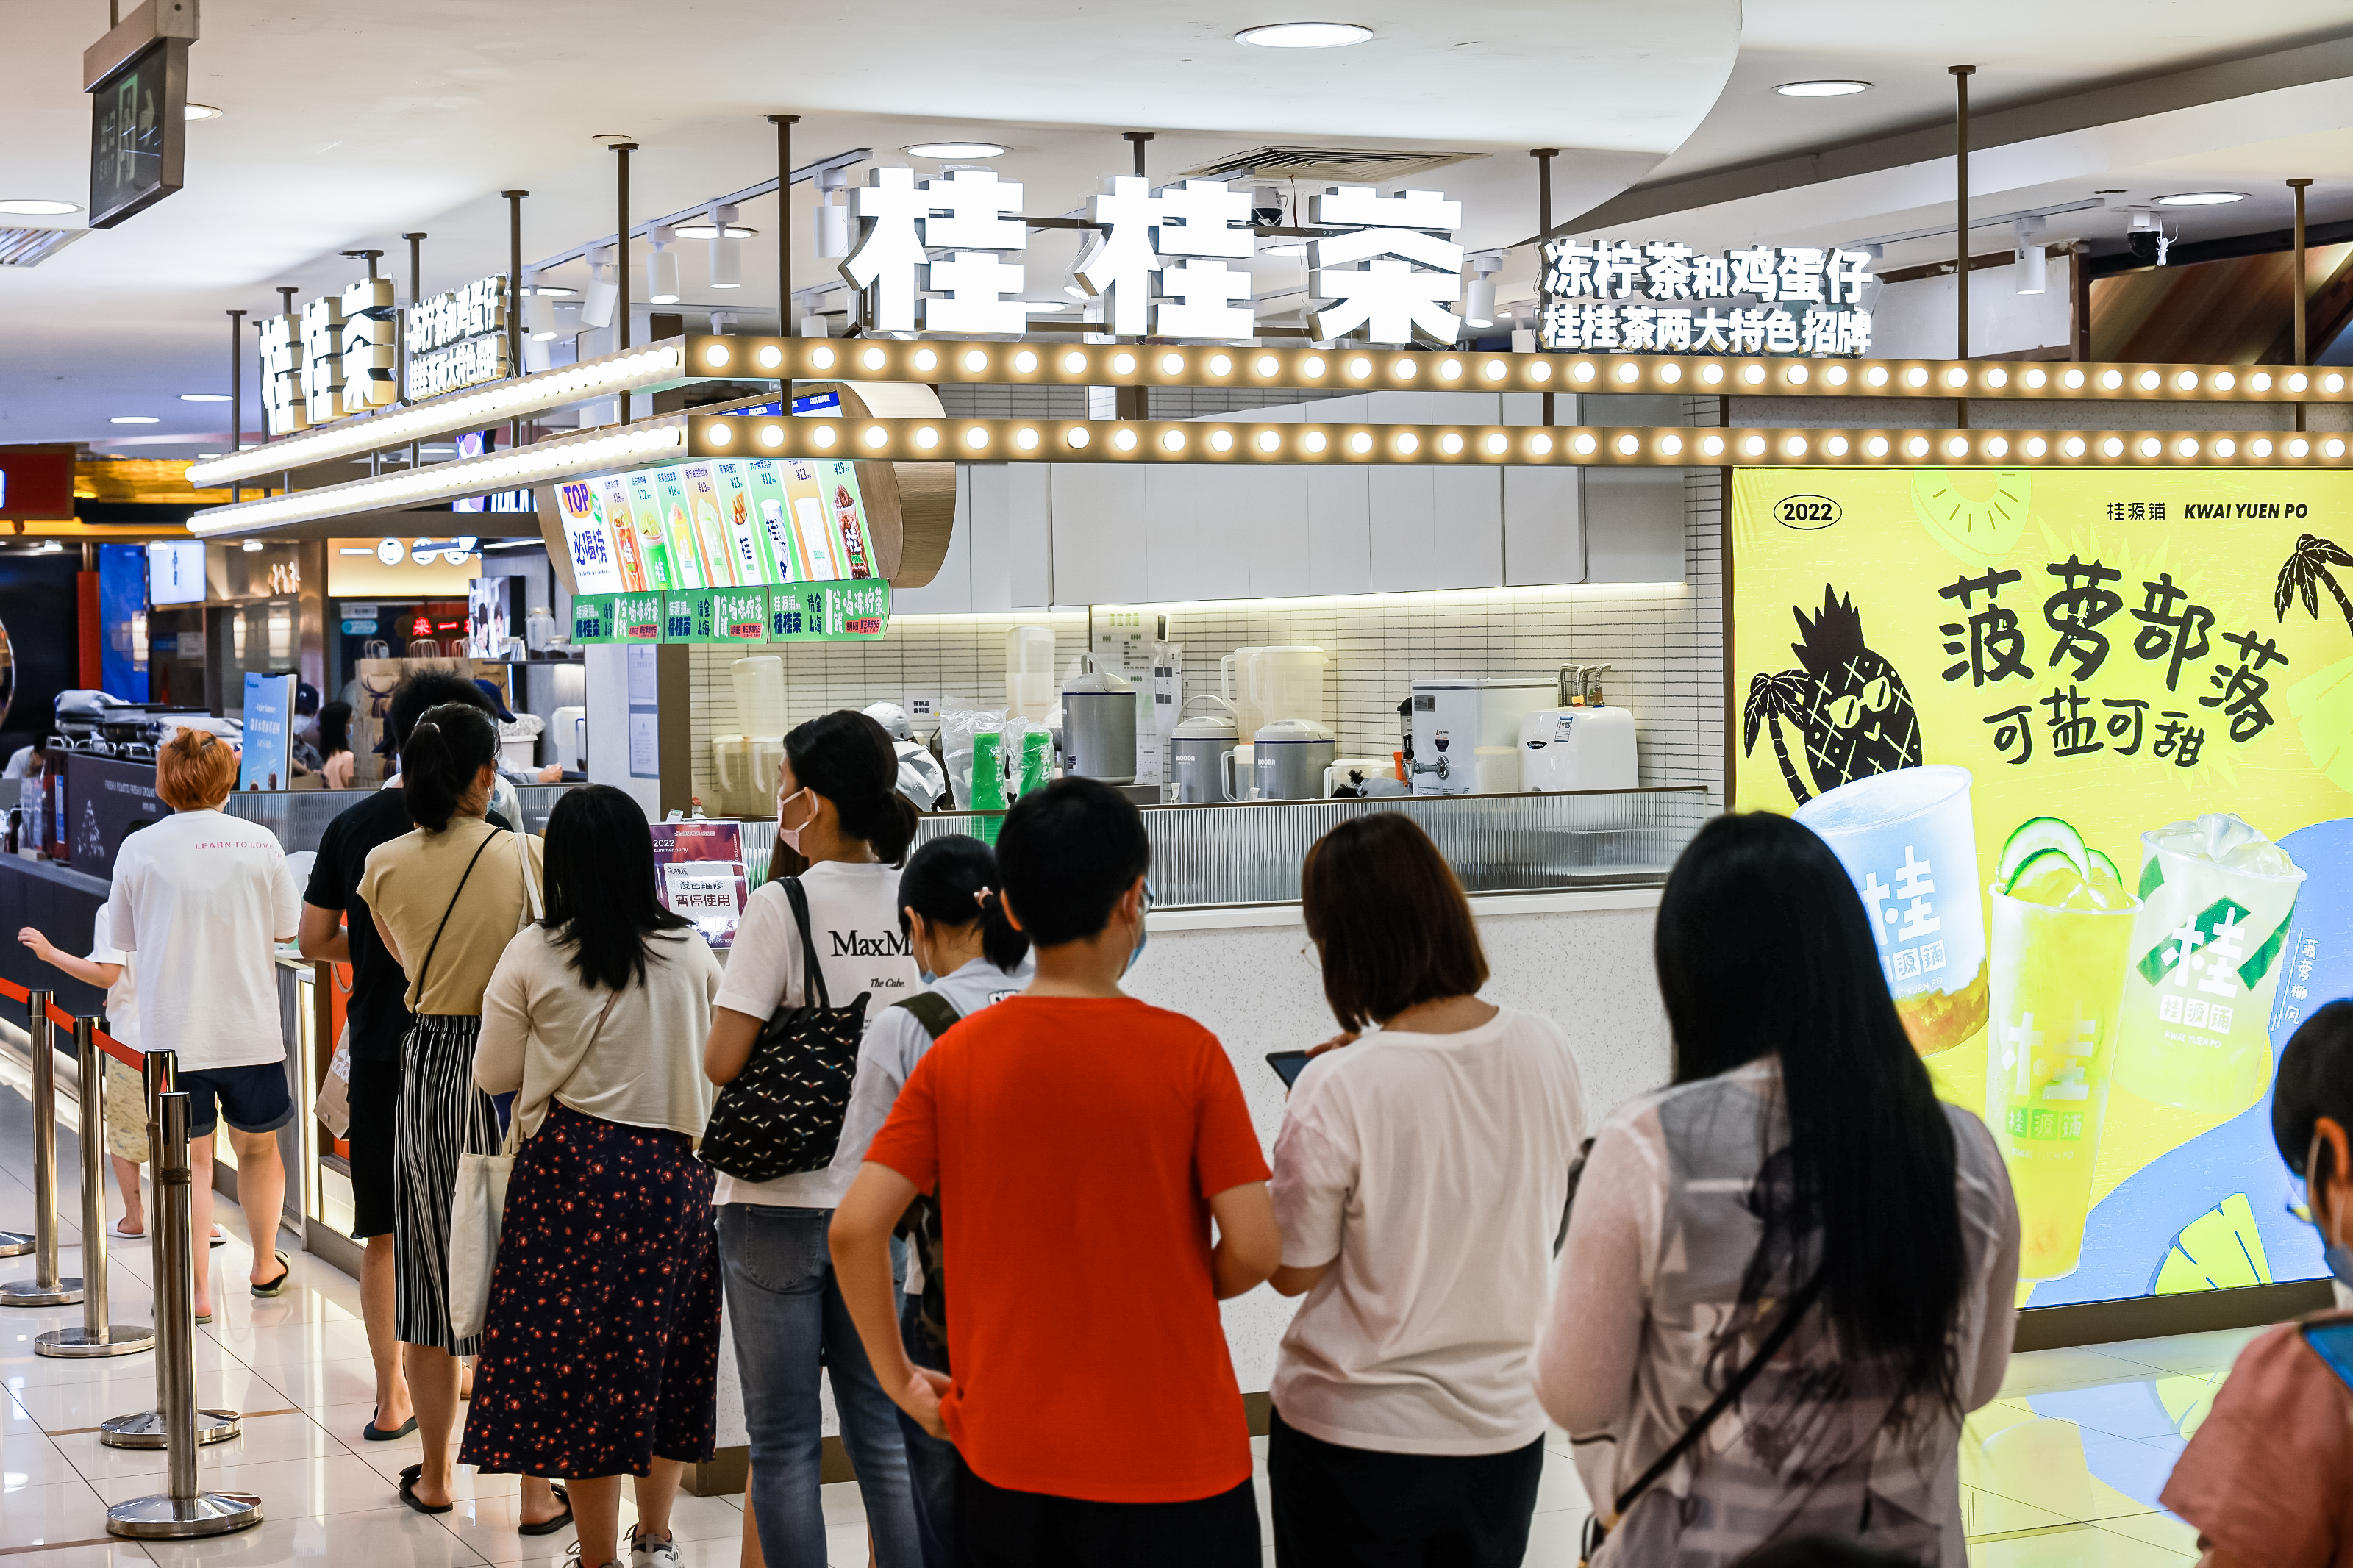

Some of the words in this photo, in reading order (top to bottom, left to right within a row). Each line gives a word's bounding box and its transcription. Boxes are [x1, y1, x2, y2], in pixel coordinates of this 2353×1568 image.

[846, 166, 1465, 346] 桂桂茶
[1544, 239, 1873, 304] 冻柠茶和鸡蛋仔
[407, 276, 499, 353] 冻柠茶和鸡蛋仔
[1543, 304, 1872, 354] 桂桂茶两大特色招牌
[259, 276, 376, 436] 桂桂茶
[408, 334, 498, 399] 桂桂茶两大特色招牌
[563, 484, 588, 513] TOP
[1783, 503, 1832, 520] 2022
[2107, 502, 2165, 520] 桂源铺
[2184, 504, 2231, 519] KWAI
[2236, 504, 2280, 519] YUEN
[2284, 503, 2308, 519] PO
[574, 528, 607, 565] 必喝榜
[729, 594, 763, 621] 喝冻柠茶
[774, 595, 795, 611] 桂源铺
[843, 586, 882, 617] 喝冻柠茶
[576, 619, 600, 638] 桂桂茶
[668, 616, 691, 637] 桂桂茶
[774, 612, 801, 634] 桂桂茶
[1938, 554, 2291, 743] 菠萝部落
[1982, 687, 2205, 768] 可盐可甜
[195, 842, 231, 850] LEARN
[250, 842, 274, 851] LOVE
[675, 894, 731, 908] 暂停使用
[1860, 845, 1941, 946] 桂
[1882, 941, 1946, 979] 源铺
[2161, 906, 2245, 998] 桂
[871, 978, 884, 987] The
[1895, 988, 1905, 999] AI
[1907, 981, 1929, 995] YUEN
[1931, 976, 1943, 989] PO
[2284, 937, 2319, 1024] 菠萝椰风
[2163, 997, 2232, 1031] 桂源铺
[2001, 999, 2096, 1101] 桂
[2165, 1031, 2185, 1042] KWAI
[2188, 1035, 2209, 1046] YUEN
[2210, 1039, 2221, 1048] PO
[2007, 1108, 2082, 1139] 桂源铺
[2012, 1147, 2033, 1159] KWAI
[2037, 1150, 2060, 1160] YUEN
[2063, 1150, 2074, 1160] PO
